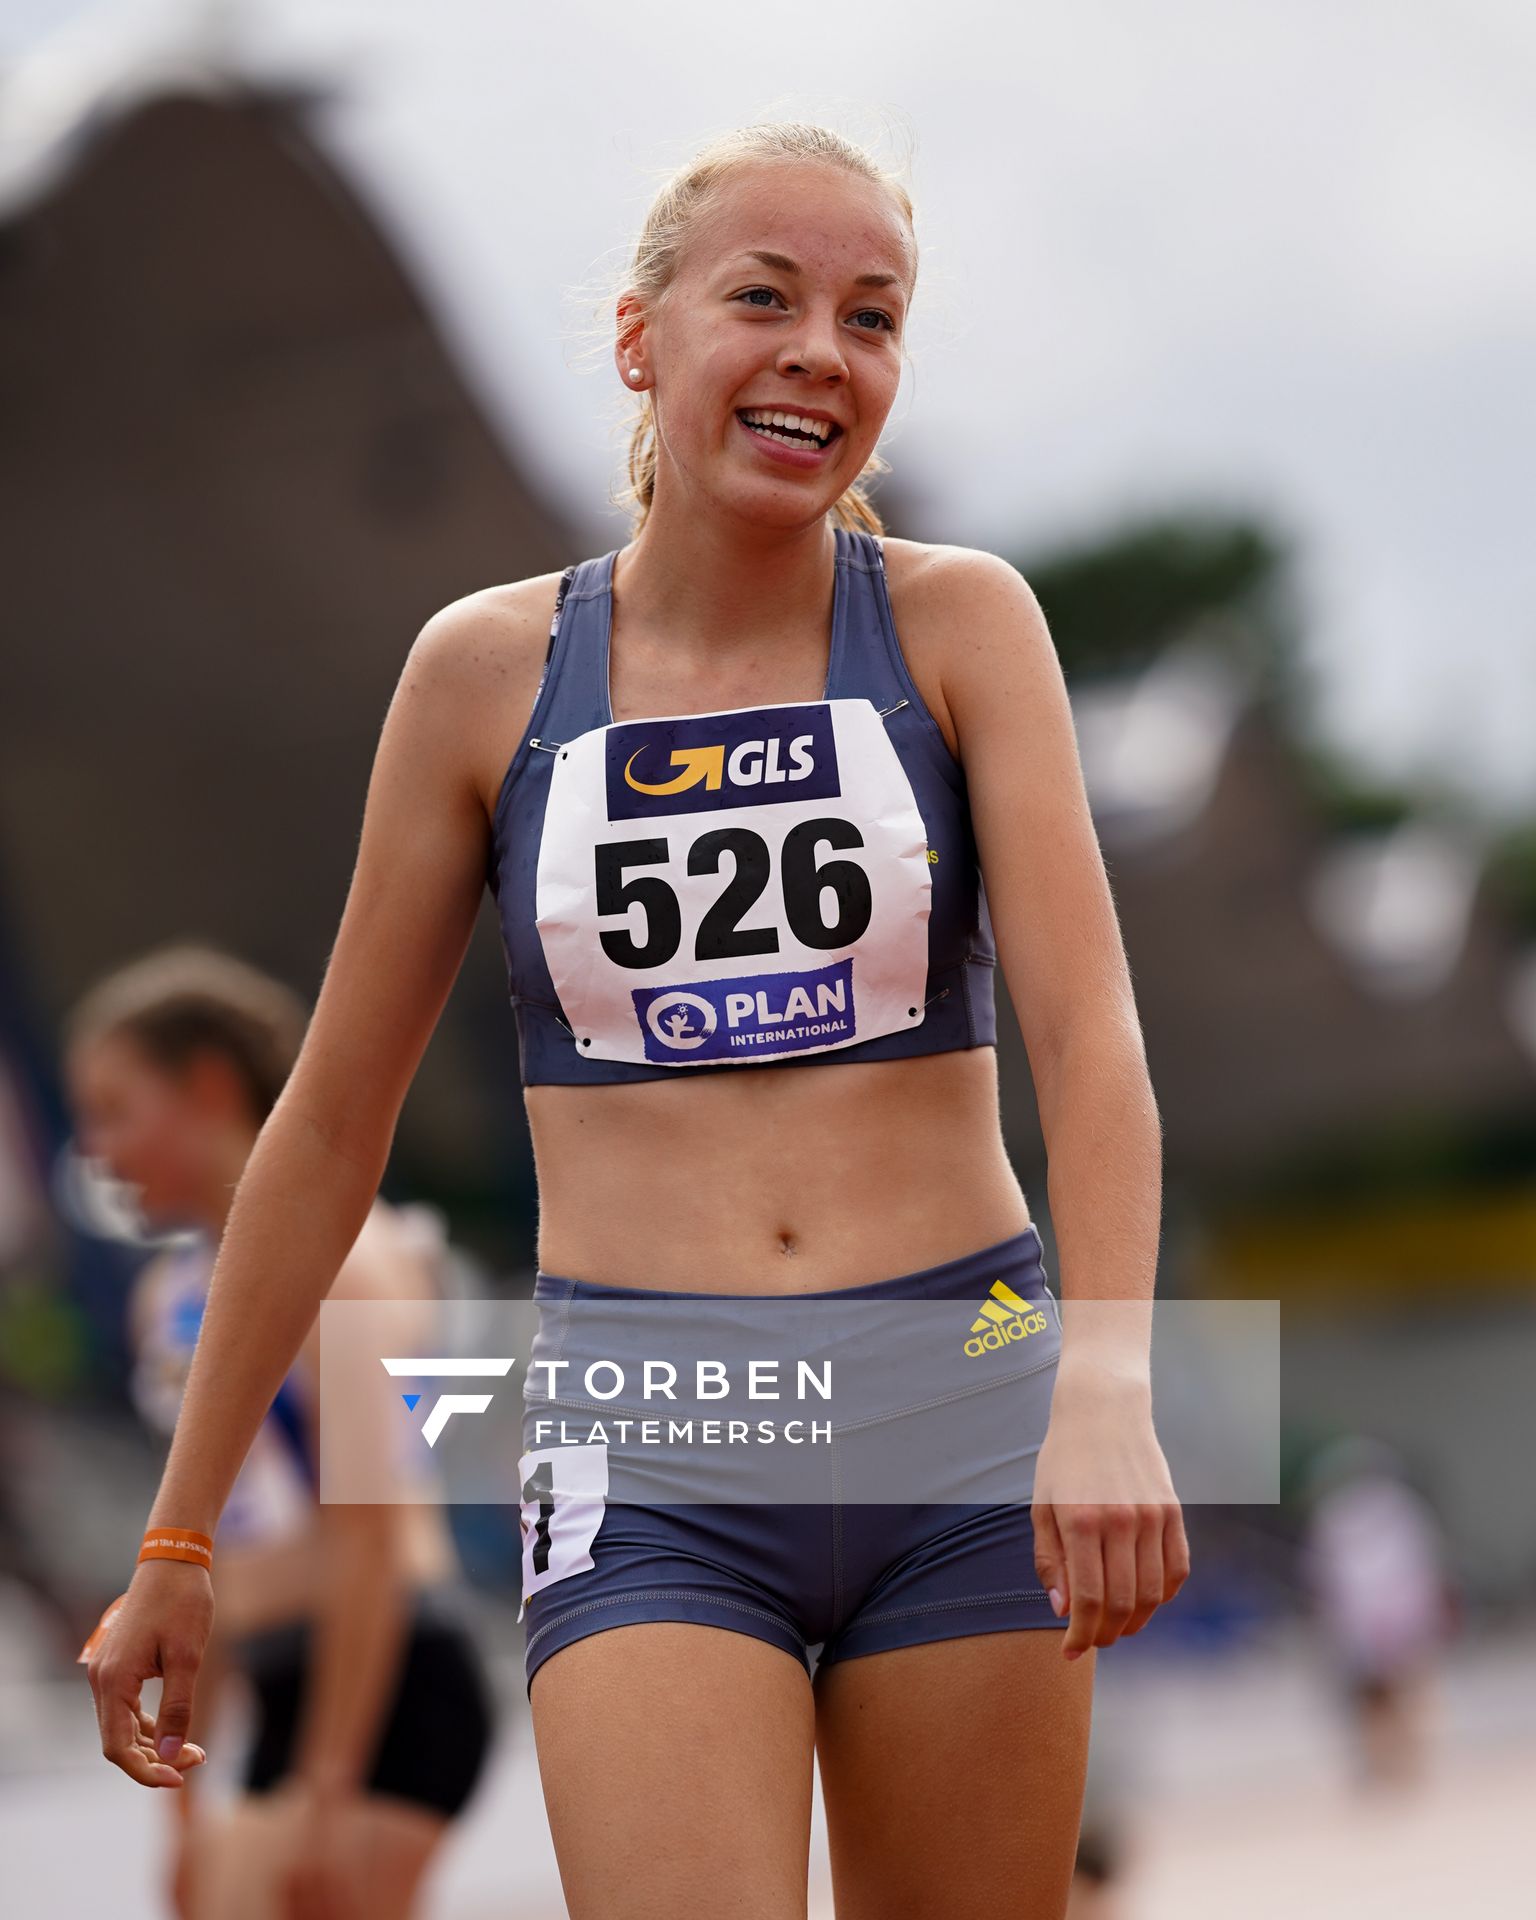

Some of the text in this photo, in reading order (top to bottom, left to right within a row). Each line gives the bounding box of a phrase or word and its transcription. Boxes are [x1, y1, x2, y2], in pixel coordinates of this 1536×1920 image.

[727, 734, 815, 786] GLS
[594, 817, 873, 970] 526
[725, 979, 847, 1028] PLAN
[730, 1019, 848, 1046] INTERNATIONAL
[963, 1311, 1047, 1358] adidas
[522, 1461, 555, 1576] 1
